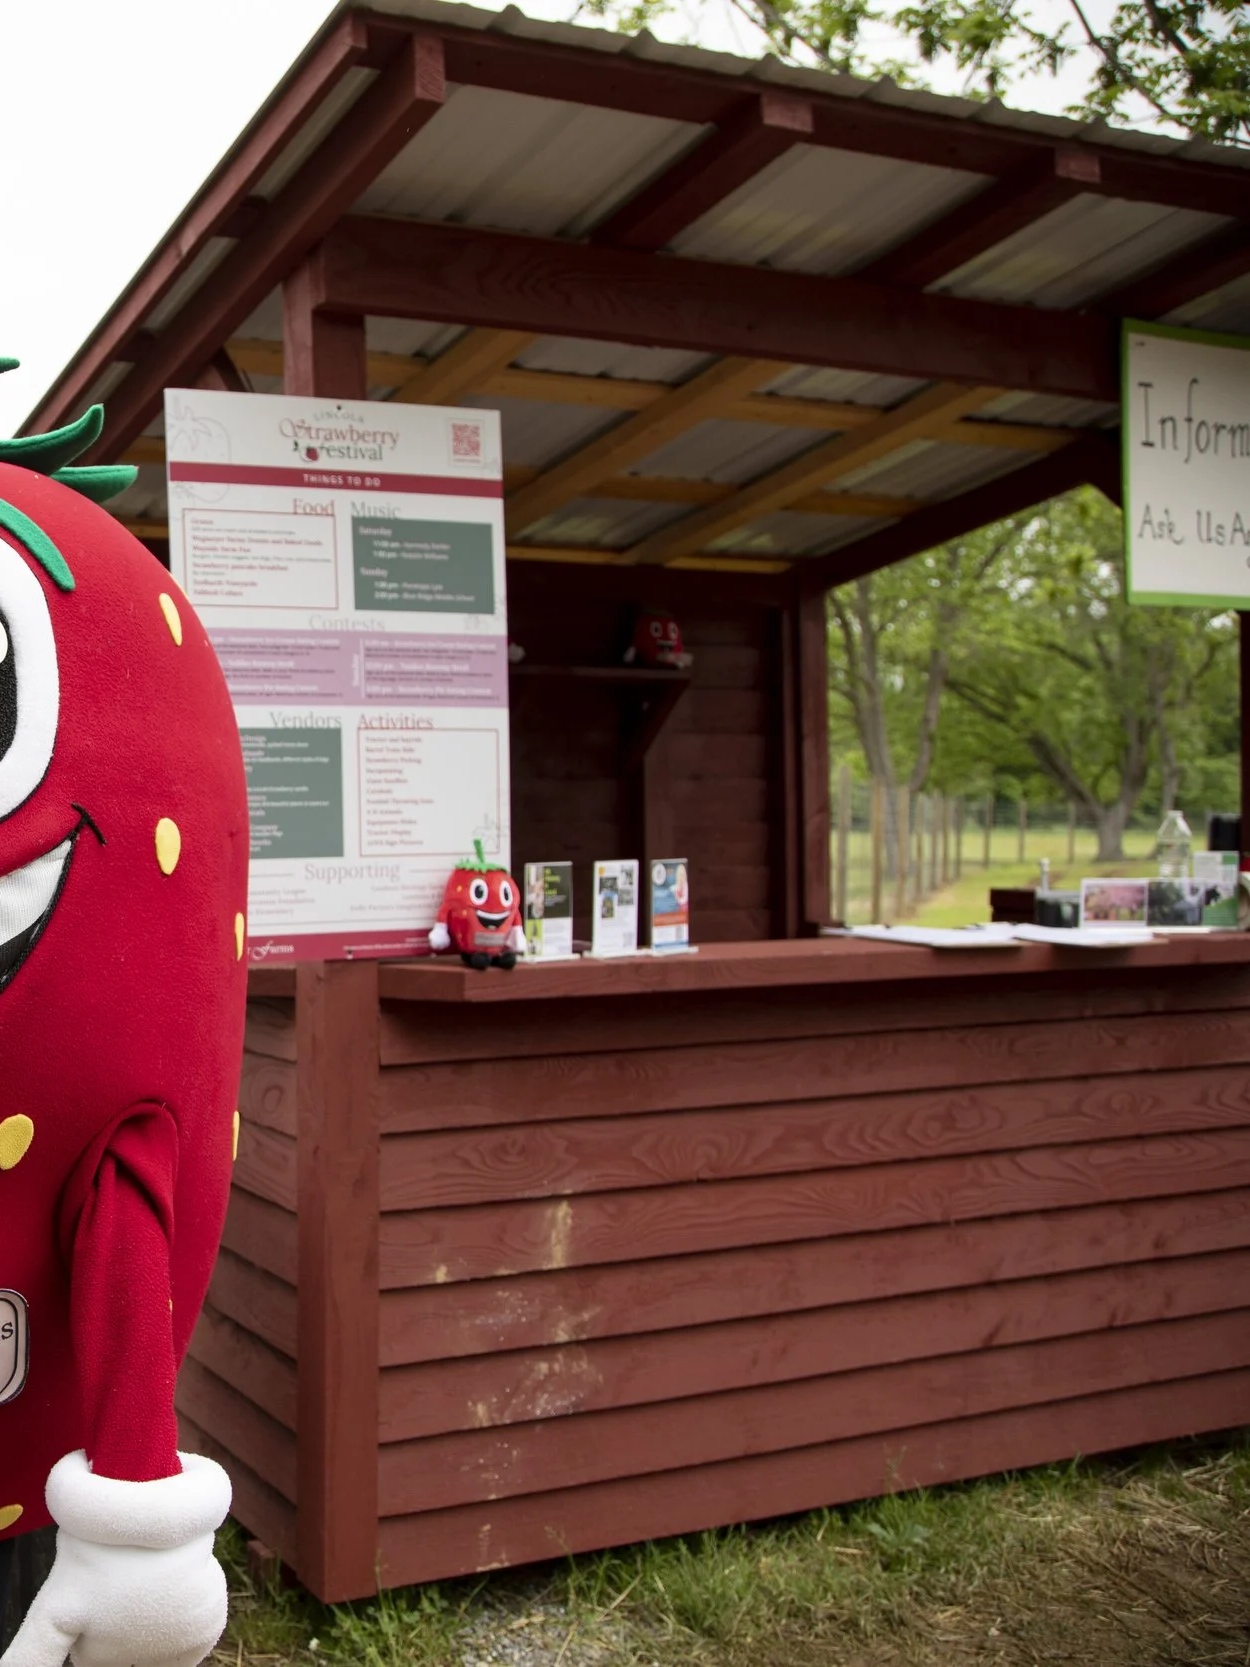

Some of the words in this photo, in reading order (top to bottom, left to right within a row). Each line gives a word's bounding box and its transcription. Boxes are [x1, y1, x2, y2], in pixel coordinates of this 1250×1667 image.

[1137, 377, 1250, 464] Inform
[278, 416, 400, 451] Strawberry
[302, 473, 344, 486] THINGS
[346, 475, 362, 487] TO
[364, 476, 382, 488] DO
[292, 497, 335, 516] Food
[350, 500, 401, 520] Music
[1138, 504, 1184, 545] Ask
[1196, 510, 1226, 546] Us
[308, 613, 387, 633] Contests
[269, 710, 343, 730] Vendors
[357, 712, 435, 730] Activities
[303, 863, 401, 885] Supporting
